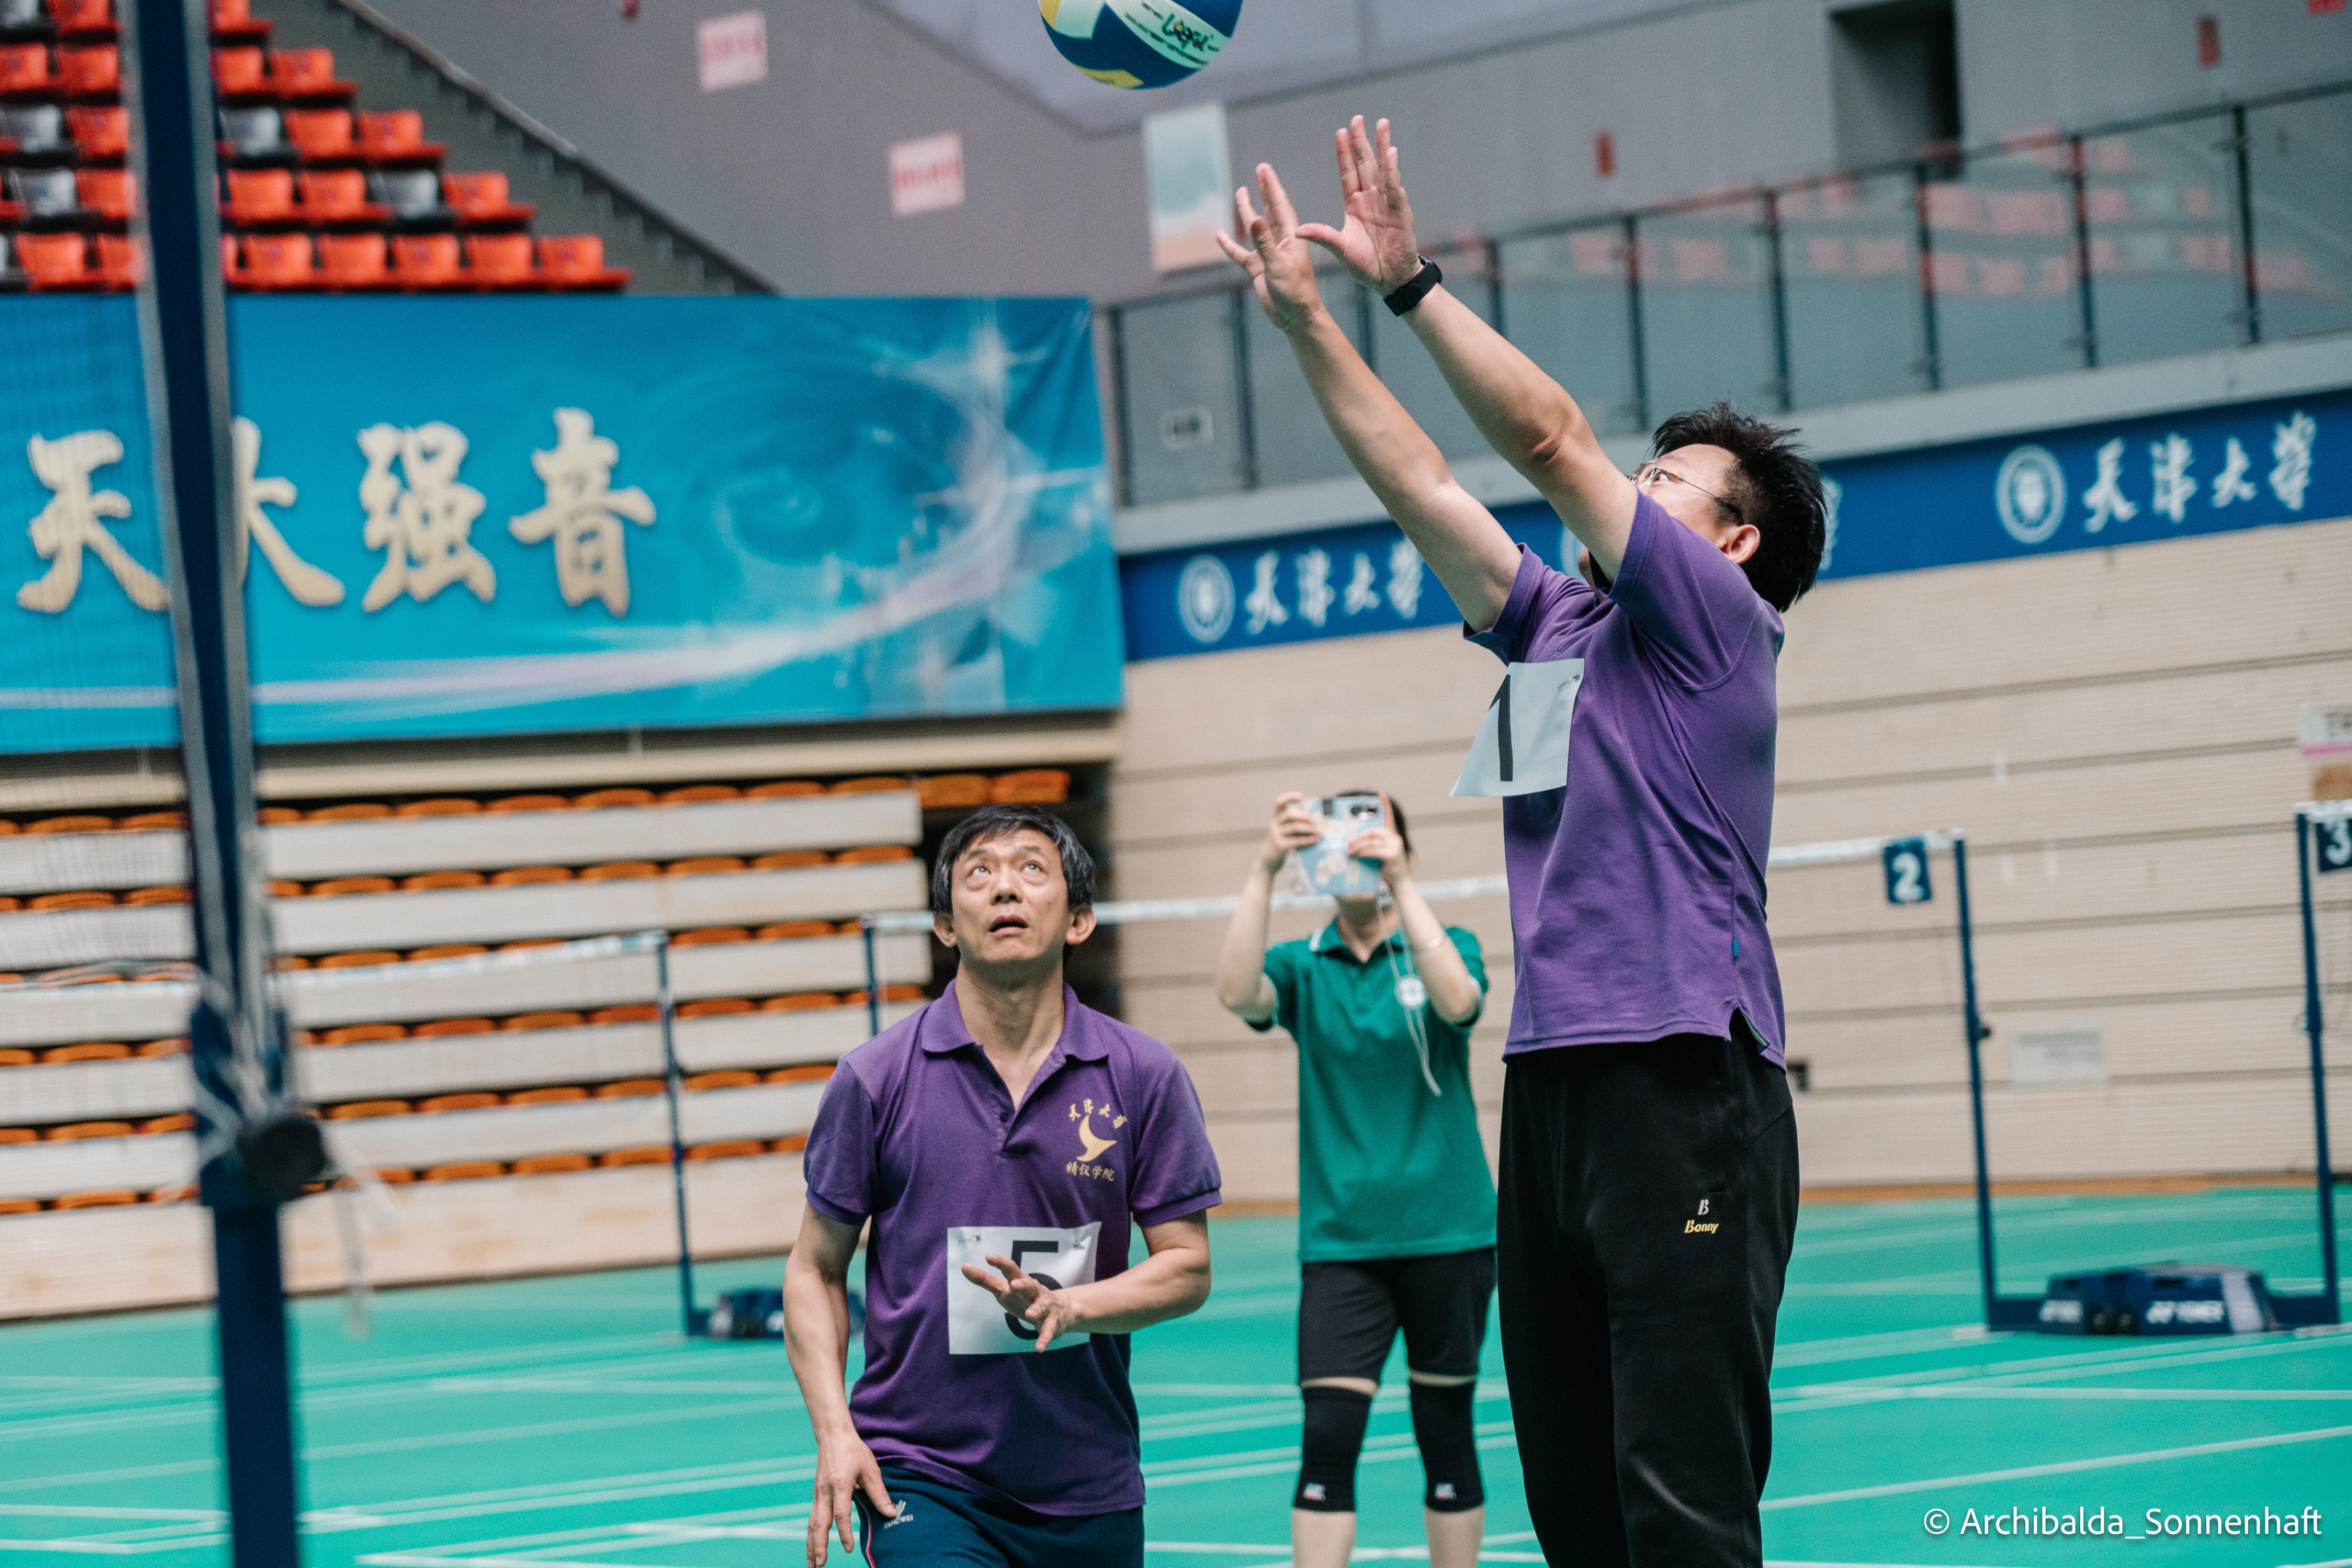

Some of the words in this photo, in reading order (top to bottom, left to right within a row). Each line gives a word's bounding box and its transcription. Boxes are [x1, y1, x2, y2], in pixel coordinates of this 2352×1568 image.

[1488, 674, 1513, 782] 1
[2323, 818, 2352, 865] 3
[1893, 852, 1926, 901] 2
[1066, 1160, 1115, 1182] 精仪学院
[1684, 1219, 1720, 1235] Bonny
[1004, 1240, 1059, 1340] 5
